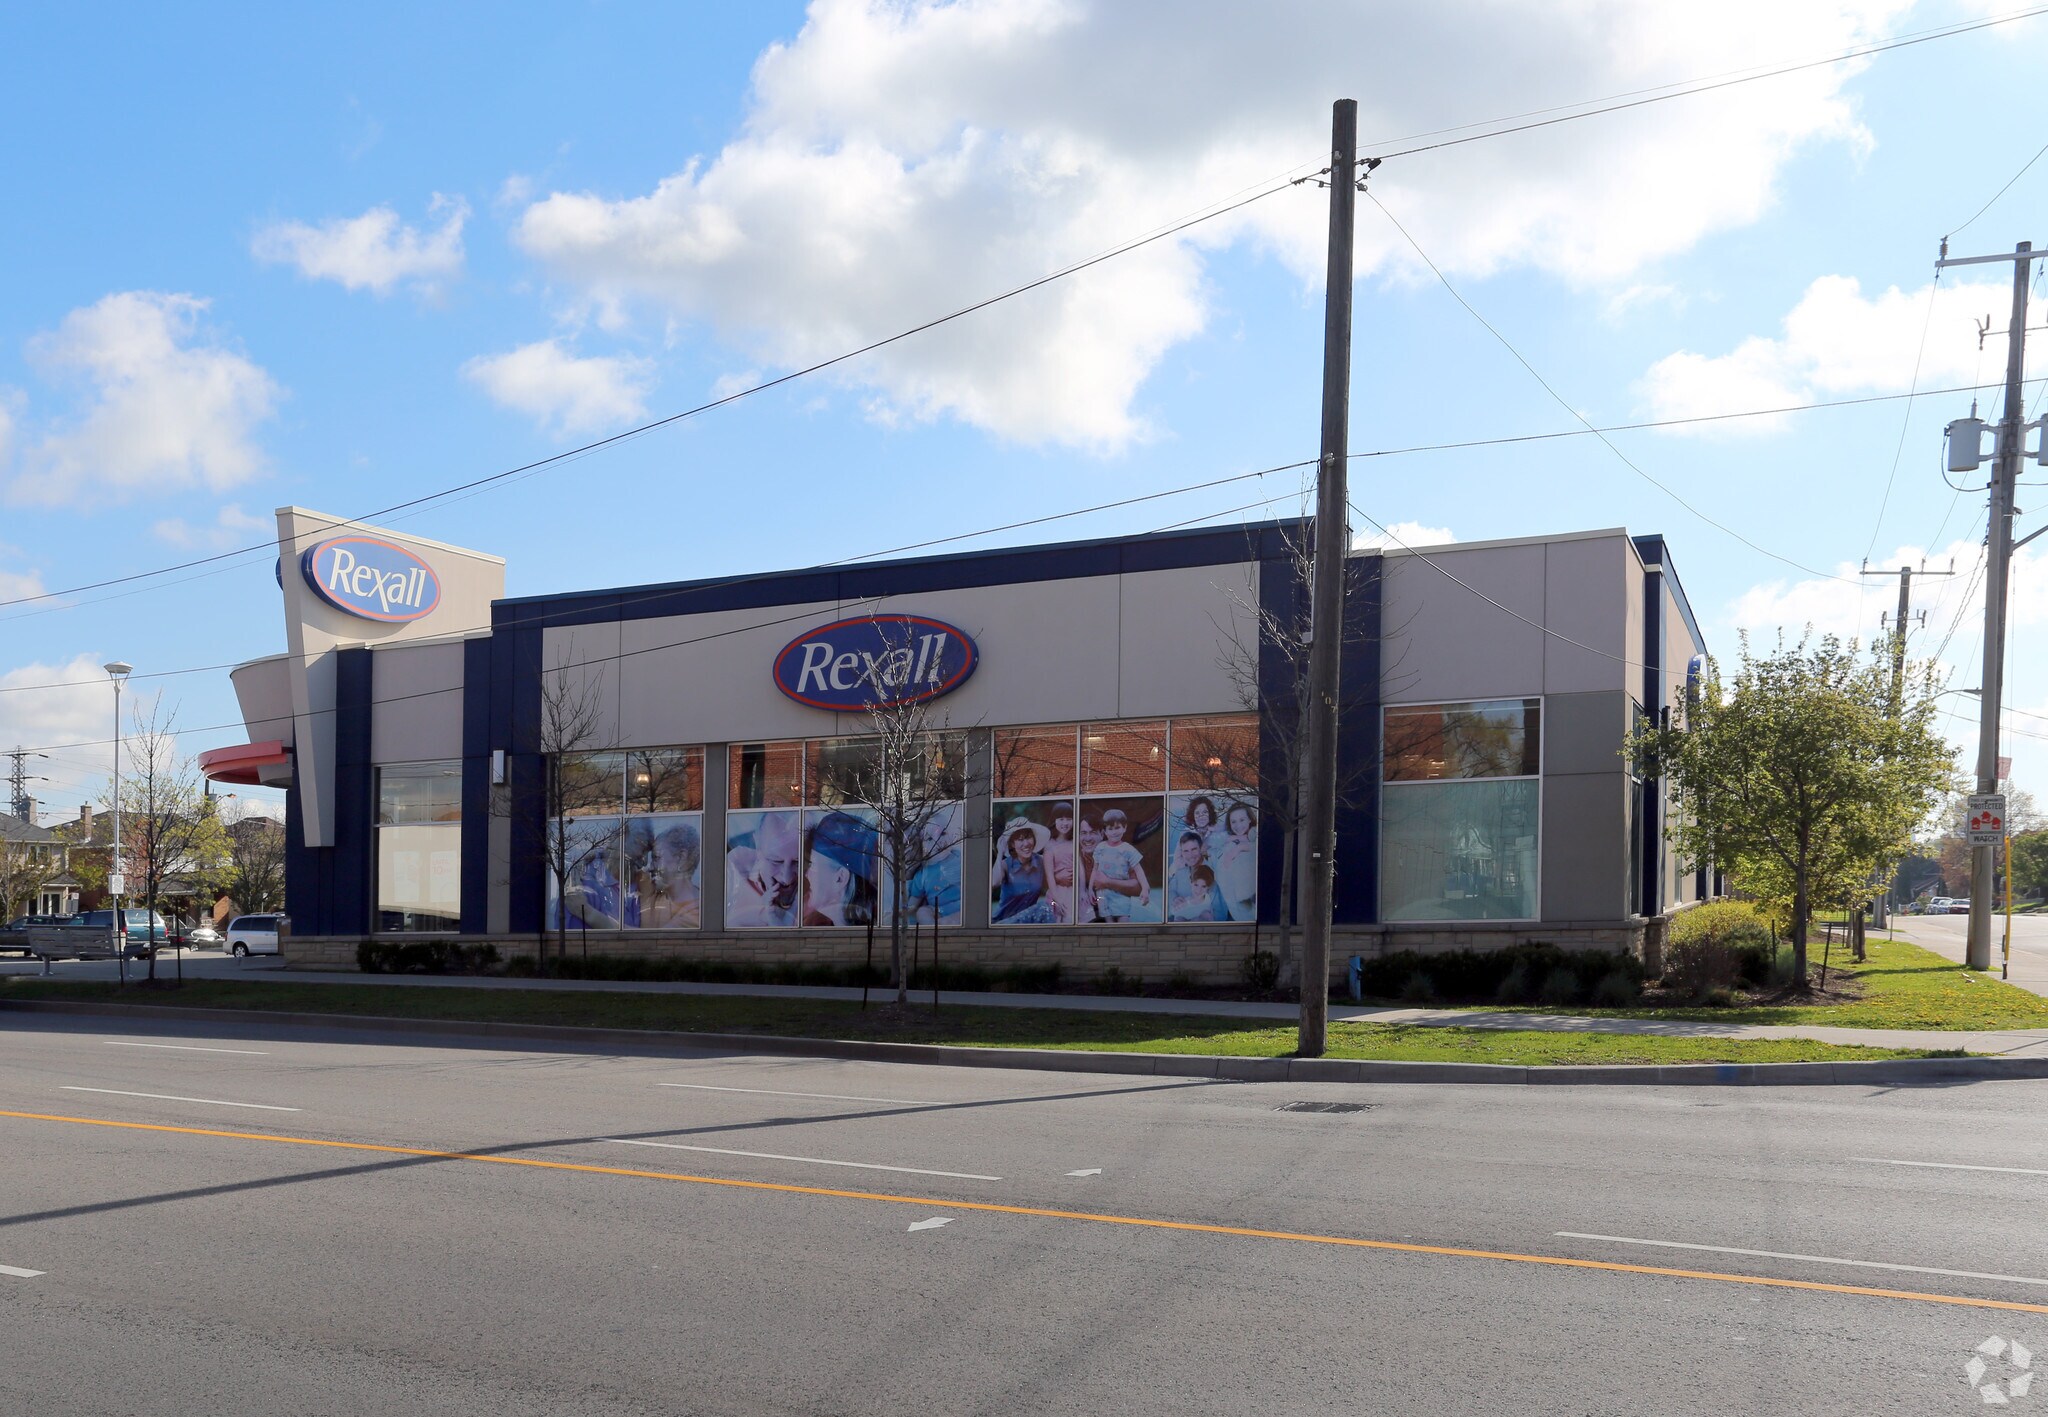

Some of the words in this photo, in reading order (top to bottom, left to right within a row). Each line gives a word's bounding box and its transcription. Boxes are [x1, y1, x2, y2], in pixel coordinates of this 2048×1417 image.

[329, 547, 427, 613] Rexall
[796, 632, 948, 700] Rexall
[1970, 802, 2003, 810] PROTECTED
